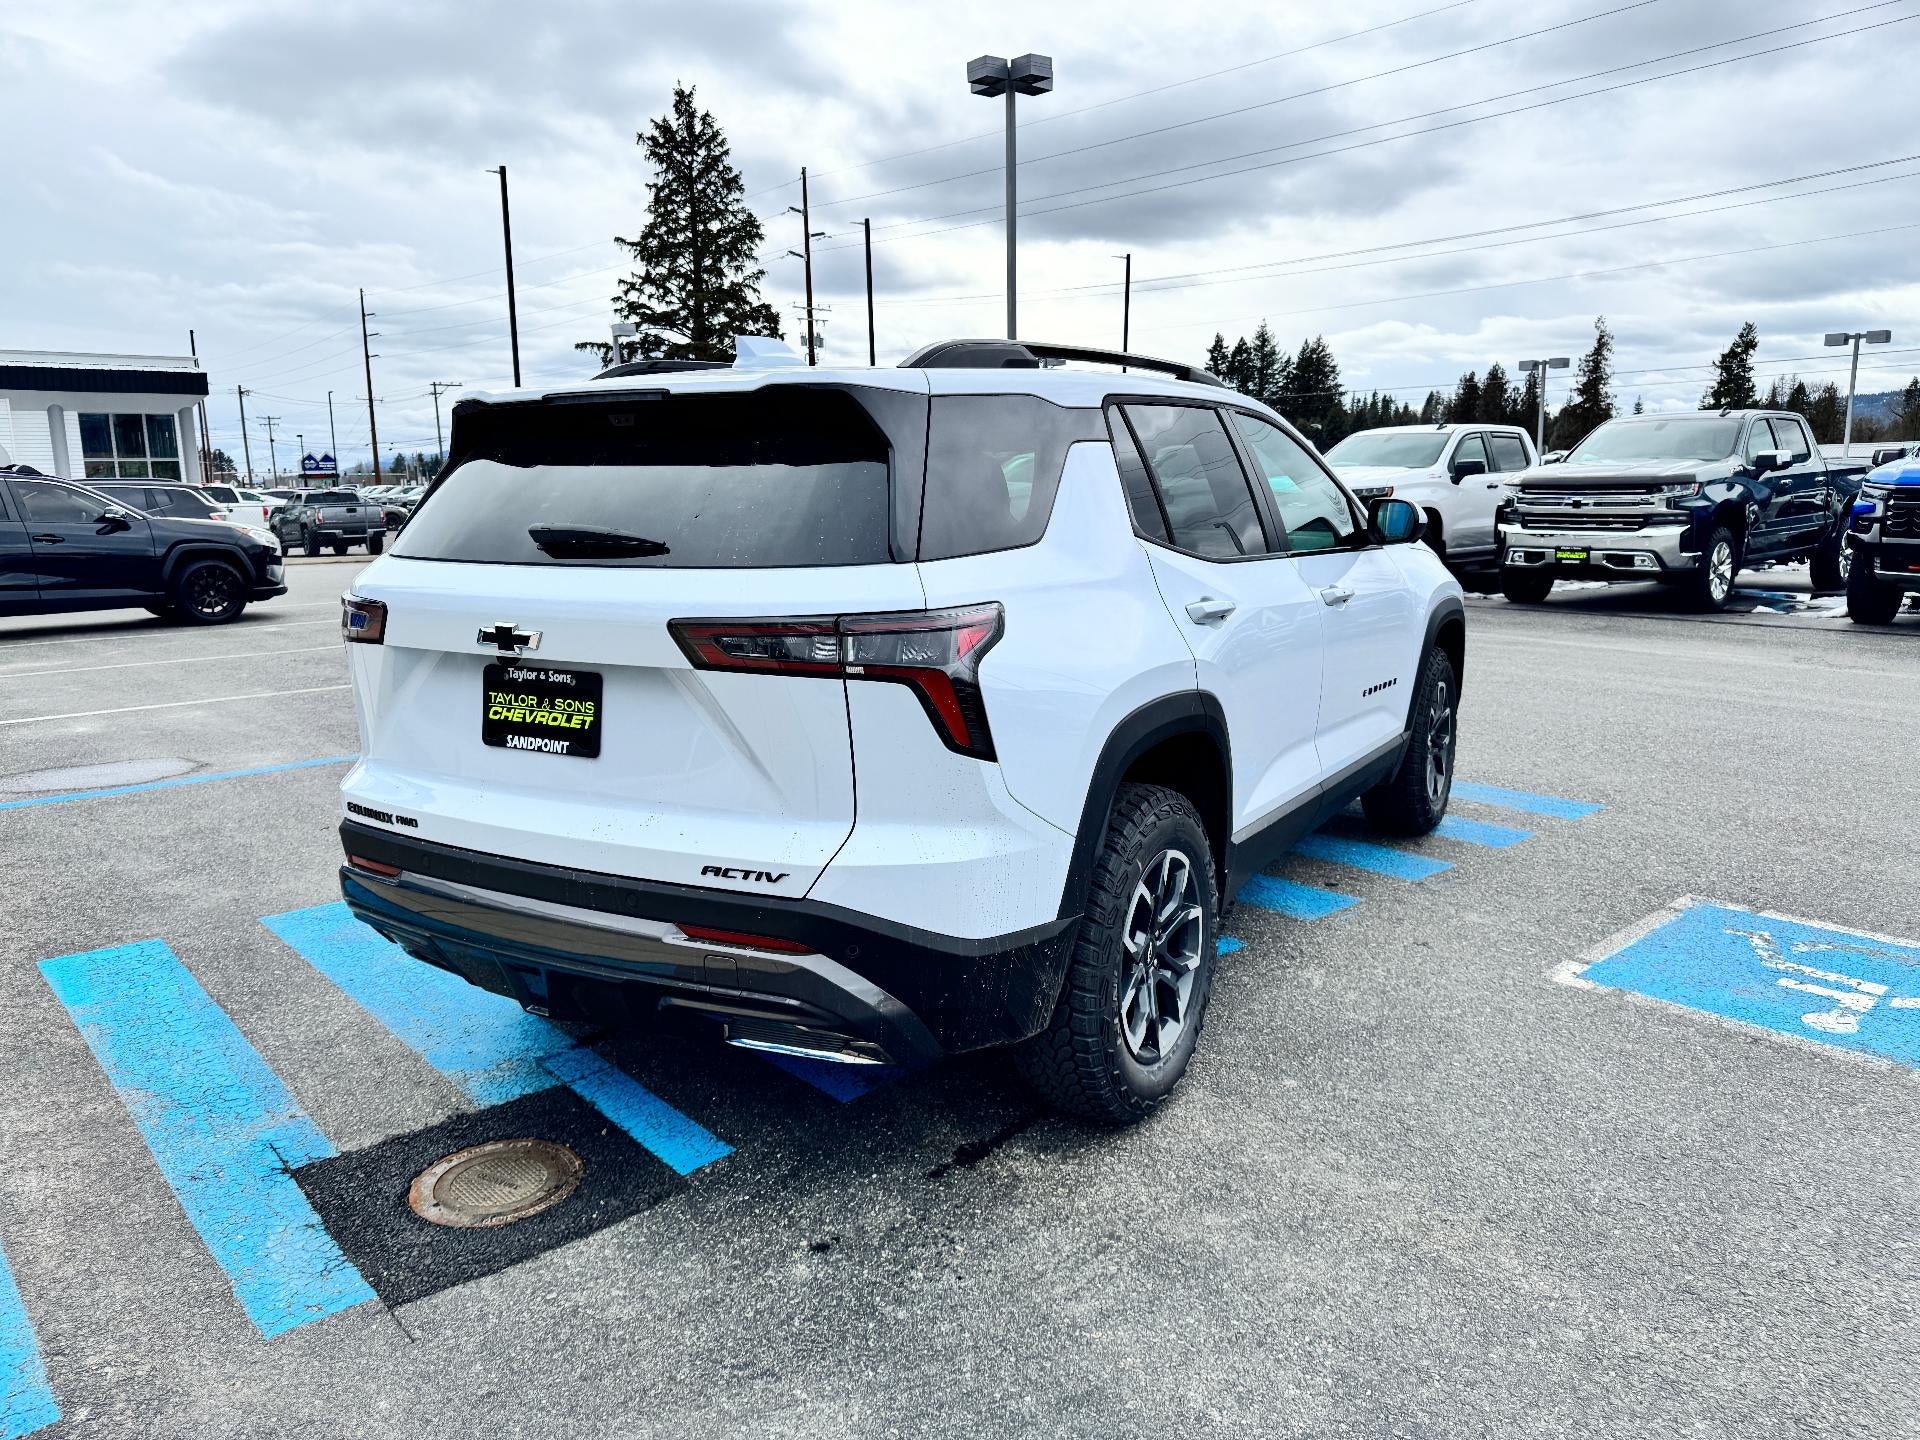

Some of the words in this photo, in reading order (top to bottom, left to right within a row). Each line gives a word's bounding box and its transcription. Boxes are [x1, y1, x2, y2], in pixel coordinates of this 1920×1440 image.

[507, 667, 538, 682] Taylor
[540, 671, 546, 680] &
[548, 670, 572, 683] Sons
[488, 691, 538, 708] TAYLOR
[541, 698, 551, 711] &
[554, 698, 595, 714] SONS
[488, 706, 594, 730] CHEVROLET
[506, 734, 570, 754] SANDPOINT
[700, 865, 791, 883] ACTIV
